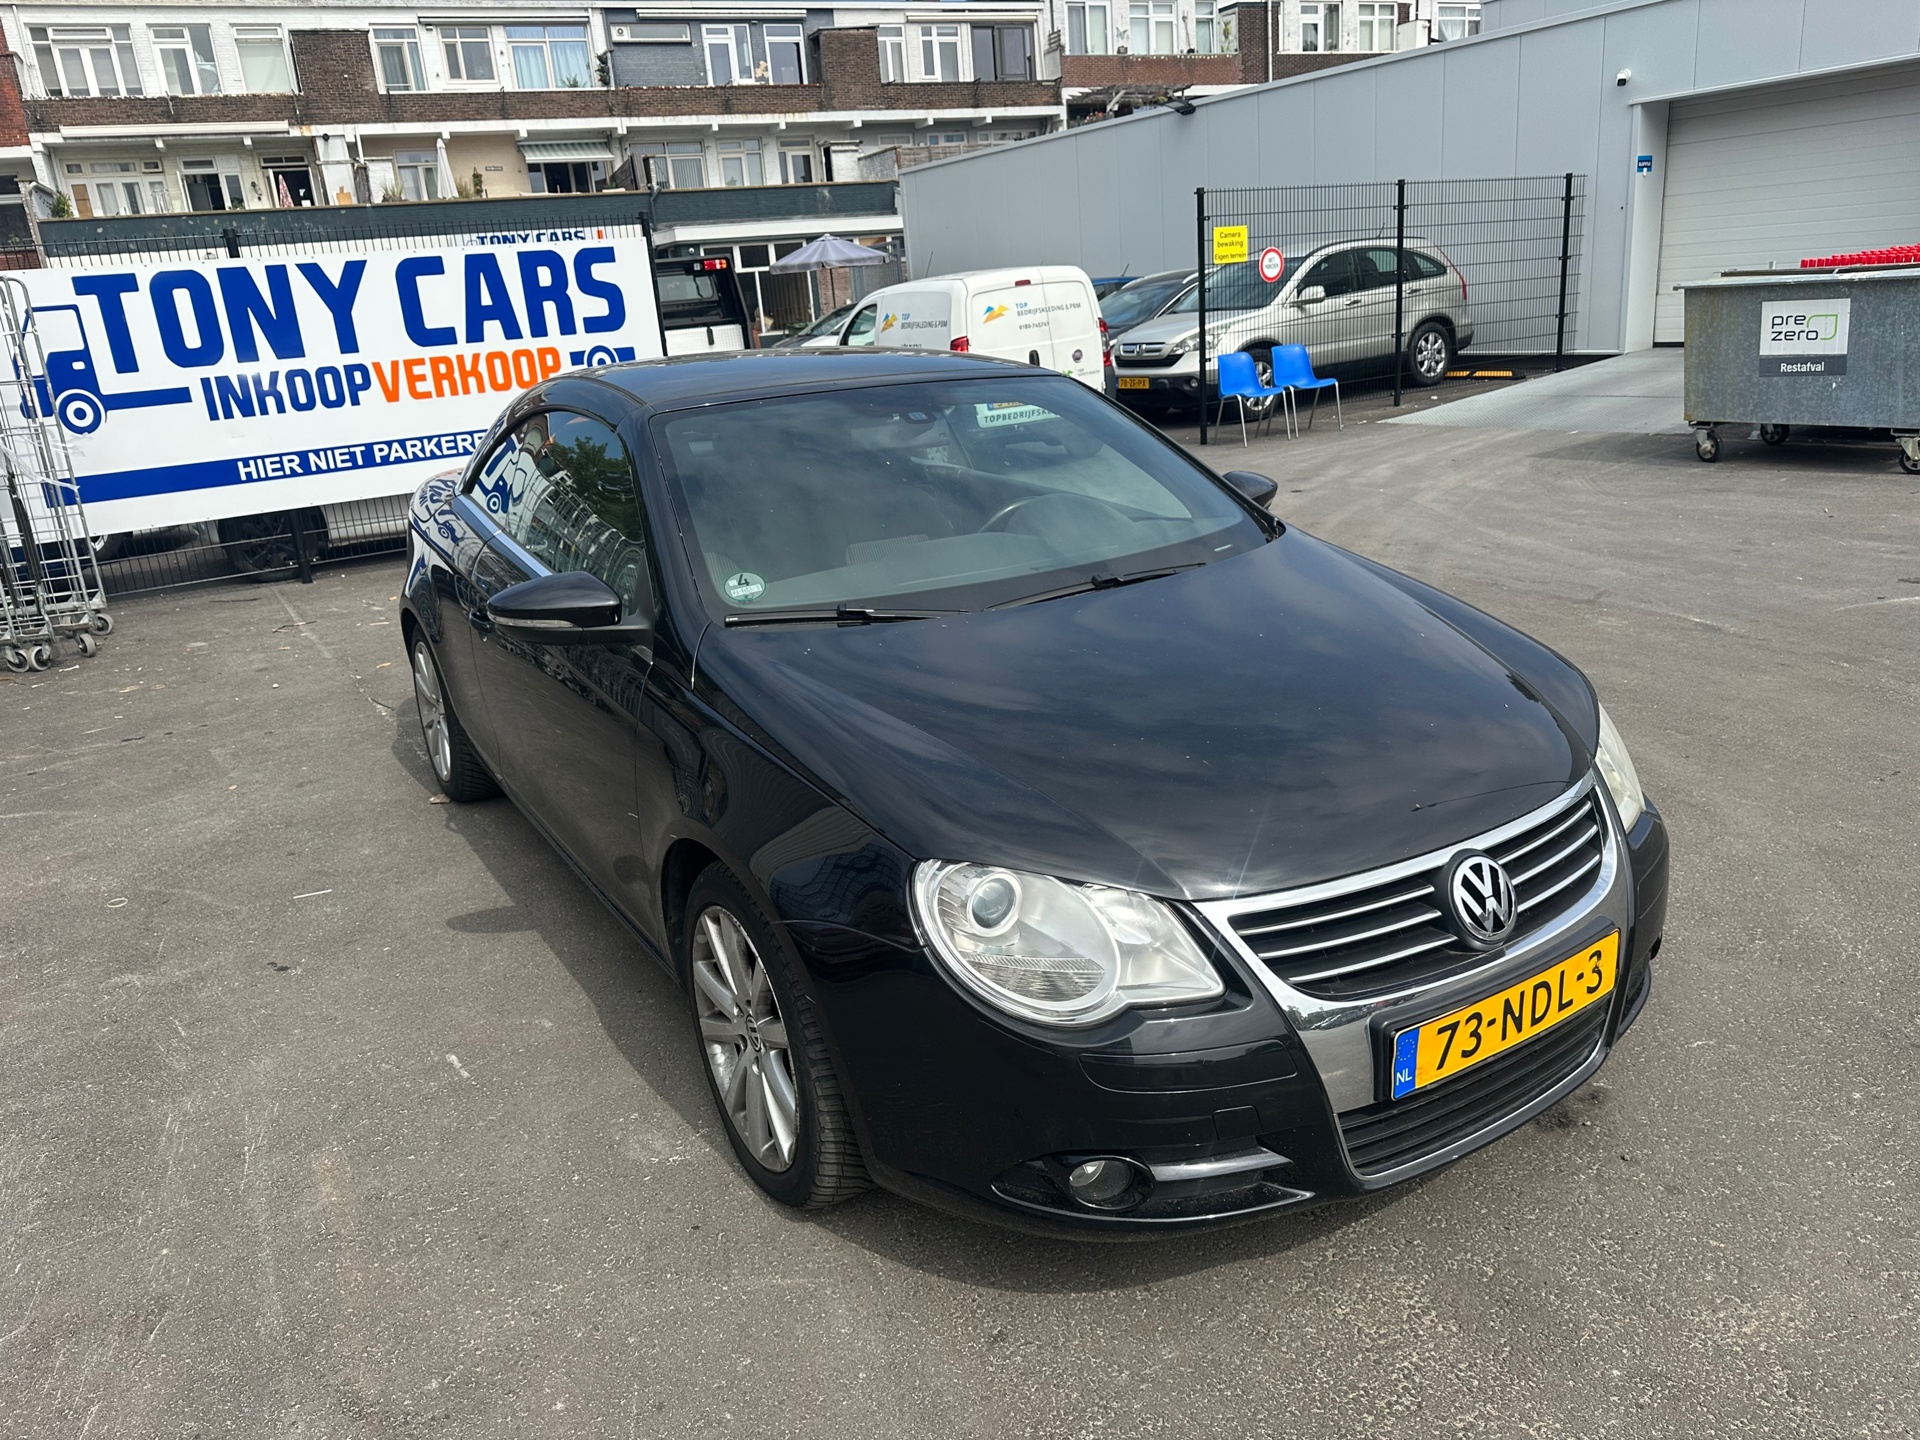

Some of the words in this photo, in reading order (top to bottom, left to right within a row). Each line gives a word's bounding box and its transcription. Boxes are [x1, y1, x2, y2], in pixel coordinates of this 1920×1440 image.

[477, 233, 531, 246] TONY
[1219, 231, 1241, 239] Camera
[1217, 240, 1244, 248] bewaking
[71, 258, 366, 374] TONY
[395, 247, 626, 347] CARS
[1070, 302, 1082, 310] PBM
[1771, 315, 1807, 330] pre
[1771, 330, 1819, 341] zero
[1780, 361, 1825, 373] Restafval
[236, 453, 303, 482] HIER
[308, 445, 367, 473] NIET
[738, 573, 750, 586] 4
[1435, 949, 1603, 1071] 73-NDL-3
[1395, 1067, 1413, 1086] NL
